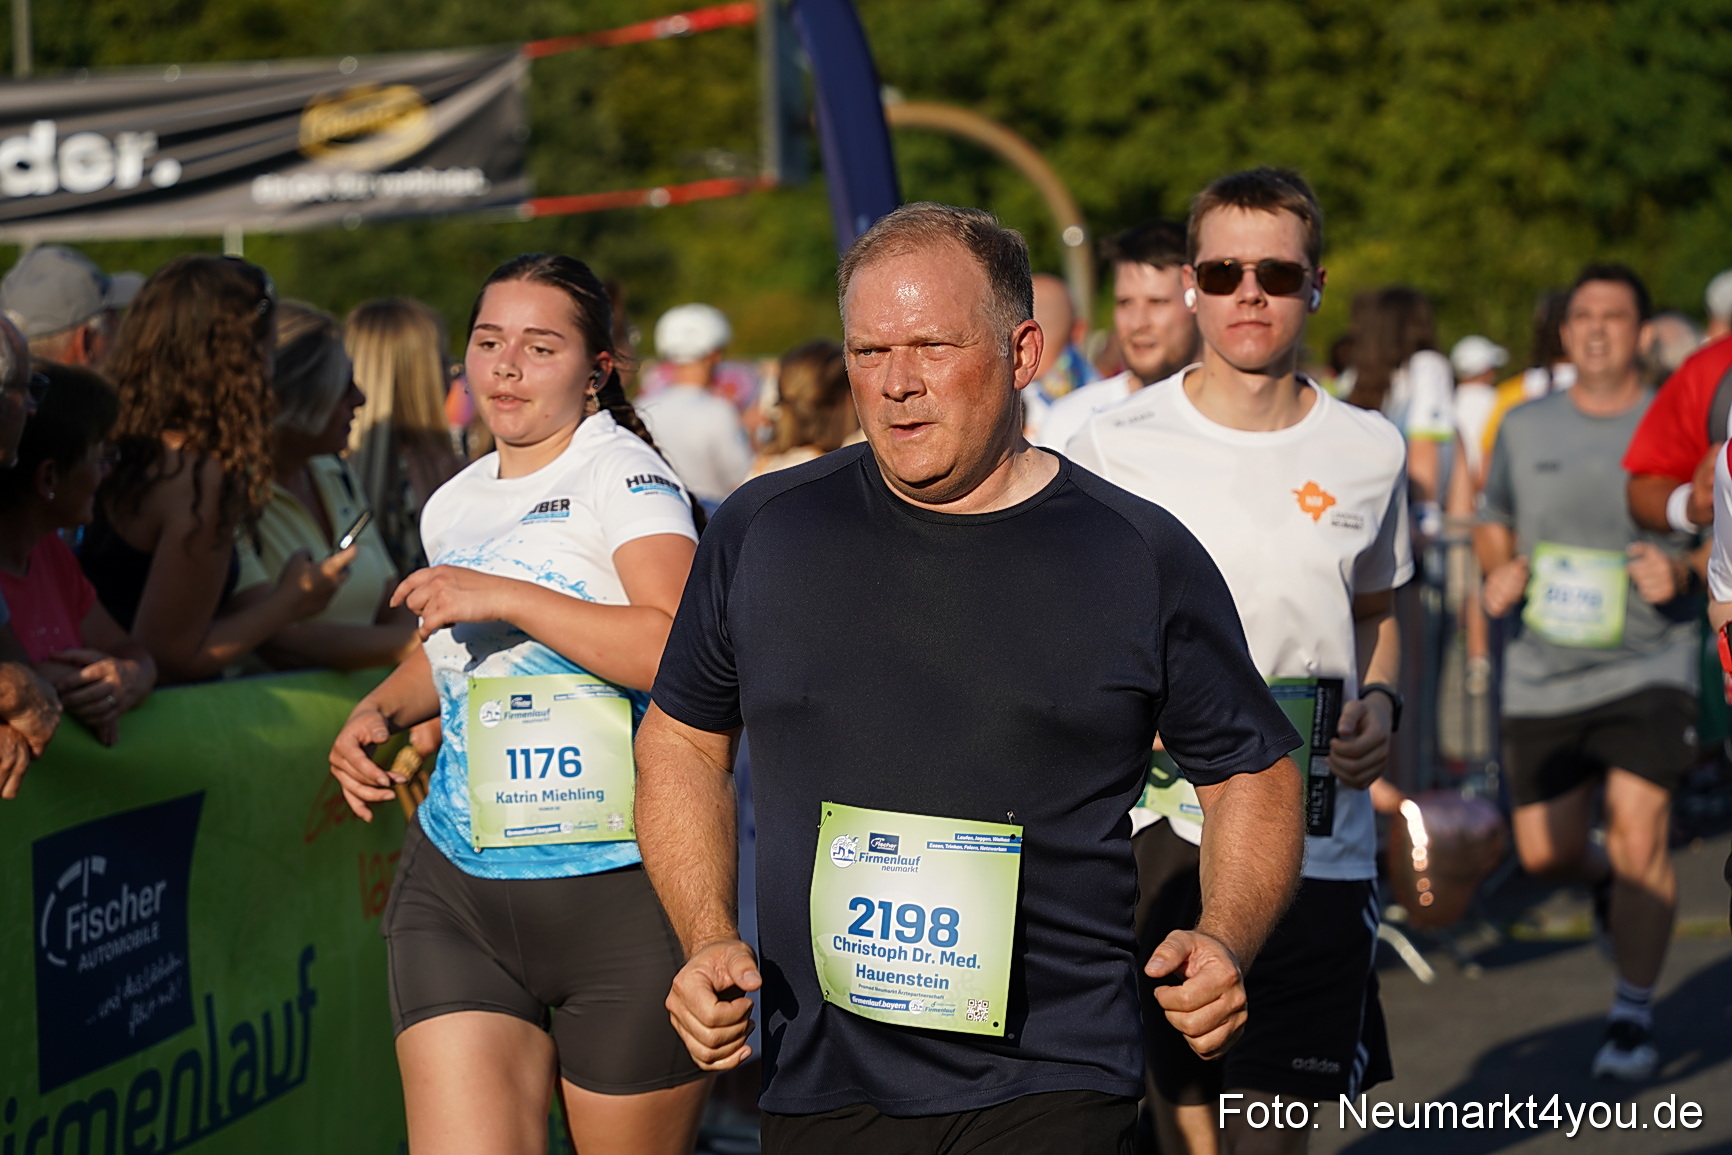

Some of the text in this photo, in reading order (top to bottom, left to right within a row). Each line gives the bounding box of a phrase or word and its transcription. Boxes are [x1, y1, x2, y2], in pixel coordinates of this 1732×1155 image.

[528, 498, 570, 514] UBER
[506, 746, 582, 780] 1176
[496, 787, 605, 804] Katrin Miehling
[859, 852, 921, 866] Firmenlauf
[881, 865, 919, 873] neumarkt
[65, 879, 168, 951] Fischer
[848, 896, 960, 948] 2198
[77, 920, 161, 974] AUTOMOBILE
[833, 935, 981, 970] Christoph Dr. Med.
[855, 963, 950, 990] Hauenstein
[858, 984, 945, 1000] Promed Neumarkt Ärztepartnerschaft
[851, 995, 907, 1011] firmenlauf.bayern
[1291, 1056, 1341, 1074] adidas
